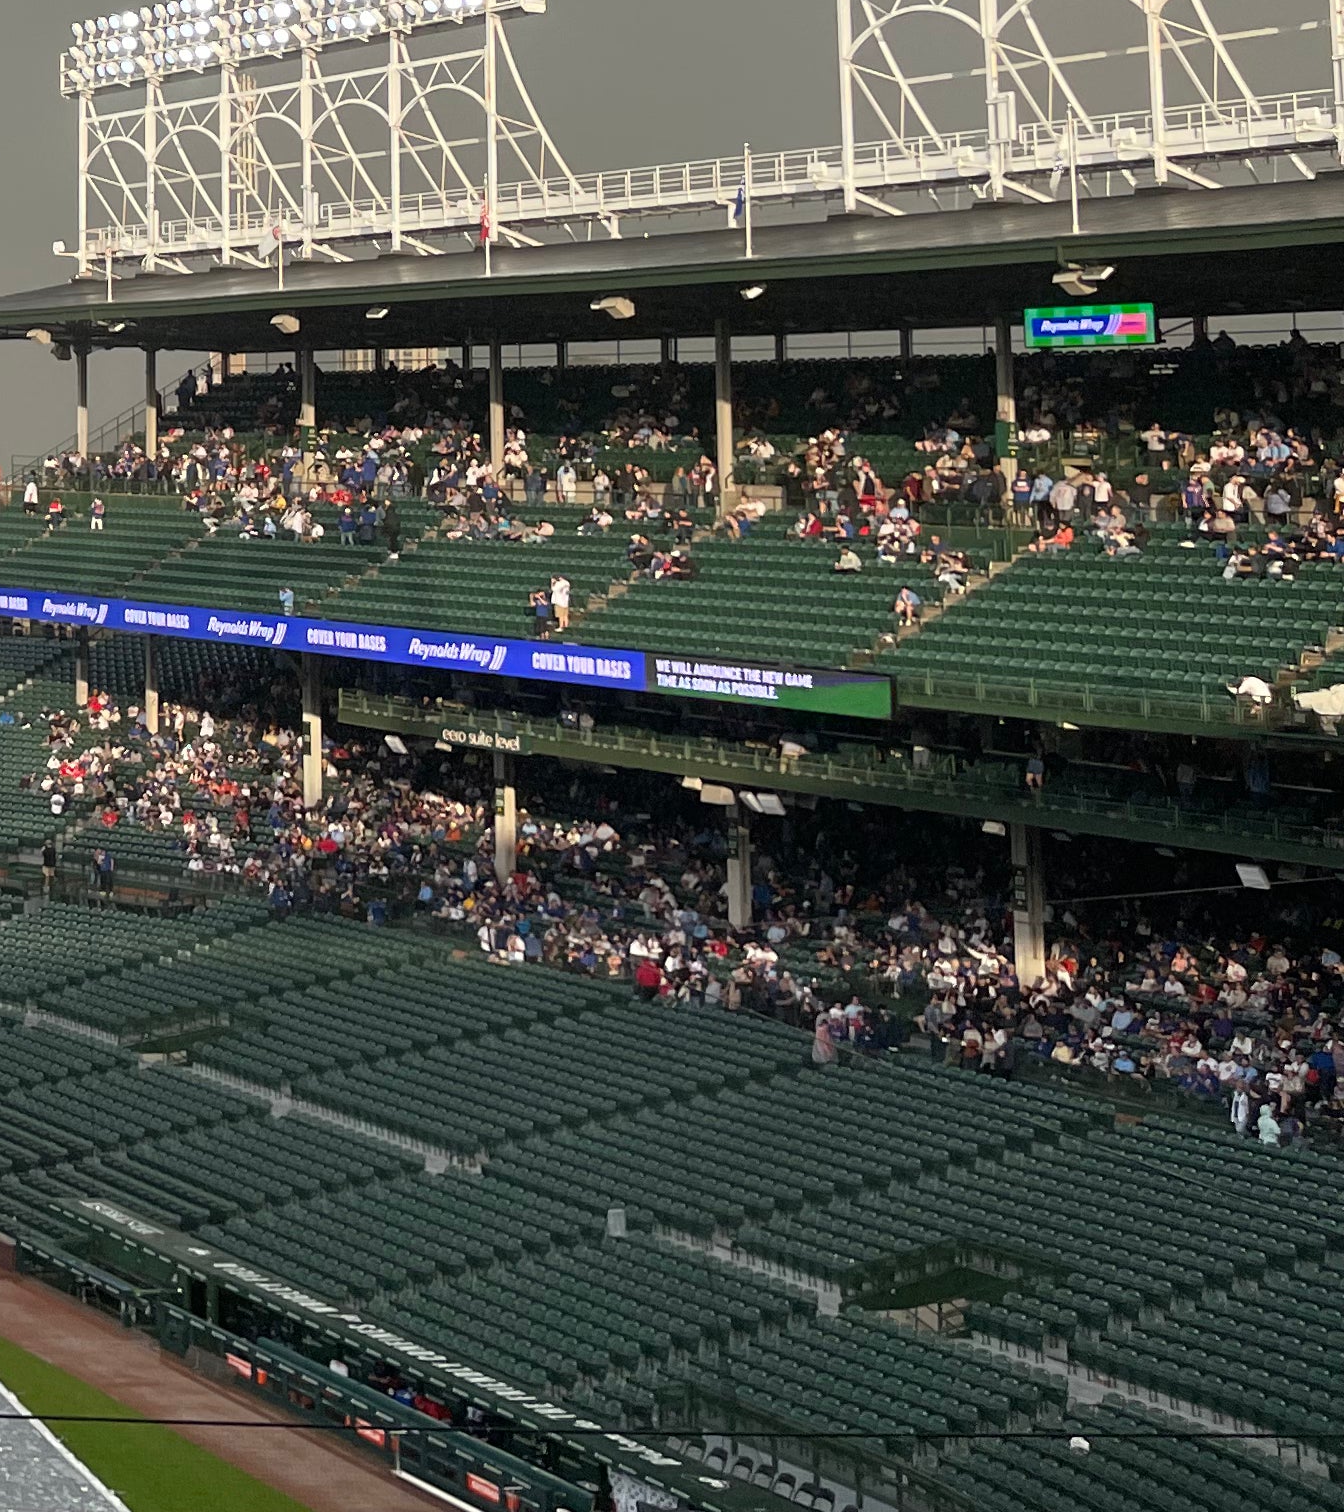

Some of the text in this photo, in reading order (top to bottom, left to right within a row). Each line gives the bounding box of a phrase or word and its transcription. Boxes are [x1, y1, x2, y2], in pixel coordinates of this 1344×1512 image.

[148, 610, 165, 626] YOUR
[207, 616, 274, 642] Reynolds Wrap
[307, 628, 386, 652] COVER YOUR BASES
[409, 637, 491, 667] Reynolds Wrap
[532, 652, 631, 679] COVER YOUR BASES
[655, 659, 813, 688] WE WILL ANNOUNCE THE NEW GAME
[678, 675, 691, 689] AS
[716, 679, 731, 693] AS
[468, 730, 492, 747] suite
[495, 732, 520, 751] level
